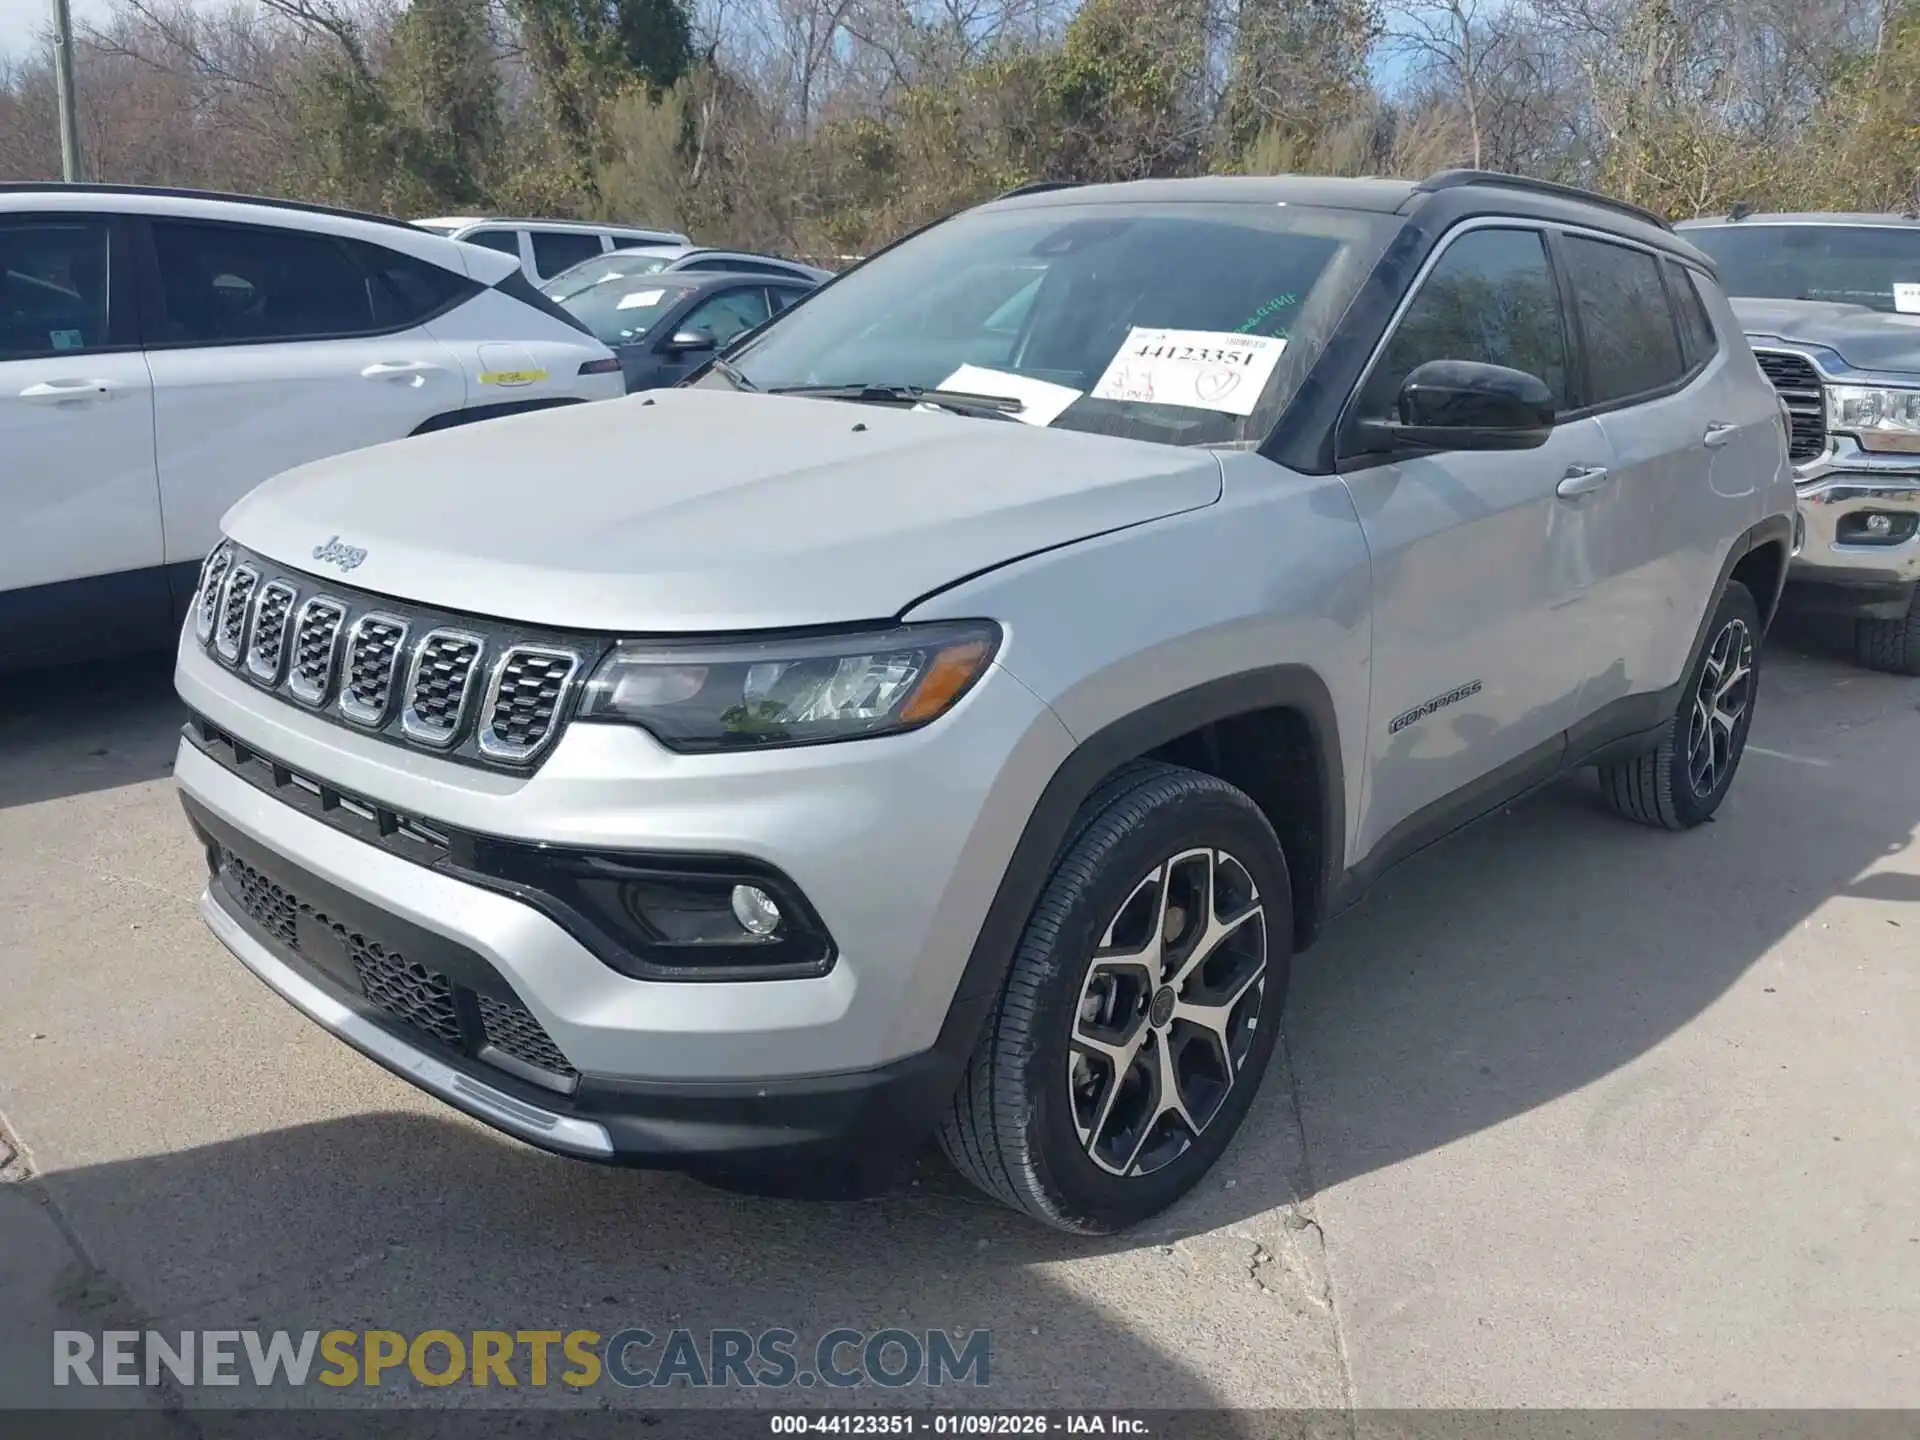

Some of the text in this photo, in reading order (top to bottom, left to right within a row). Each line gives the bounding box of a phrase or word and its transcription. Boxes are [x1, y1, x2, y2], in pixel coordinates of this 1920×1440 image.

[1134, 345, 1254, 366] 44123351
[312, 535, 368, 573] Jeep
[1389, 679, 1482, 733] COMPASS
